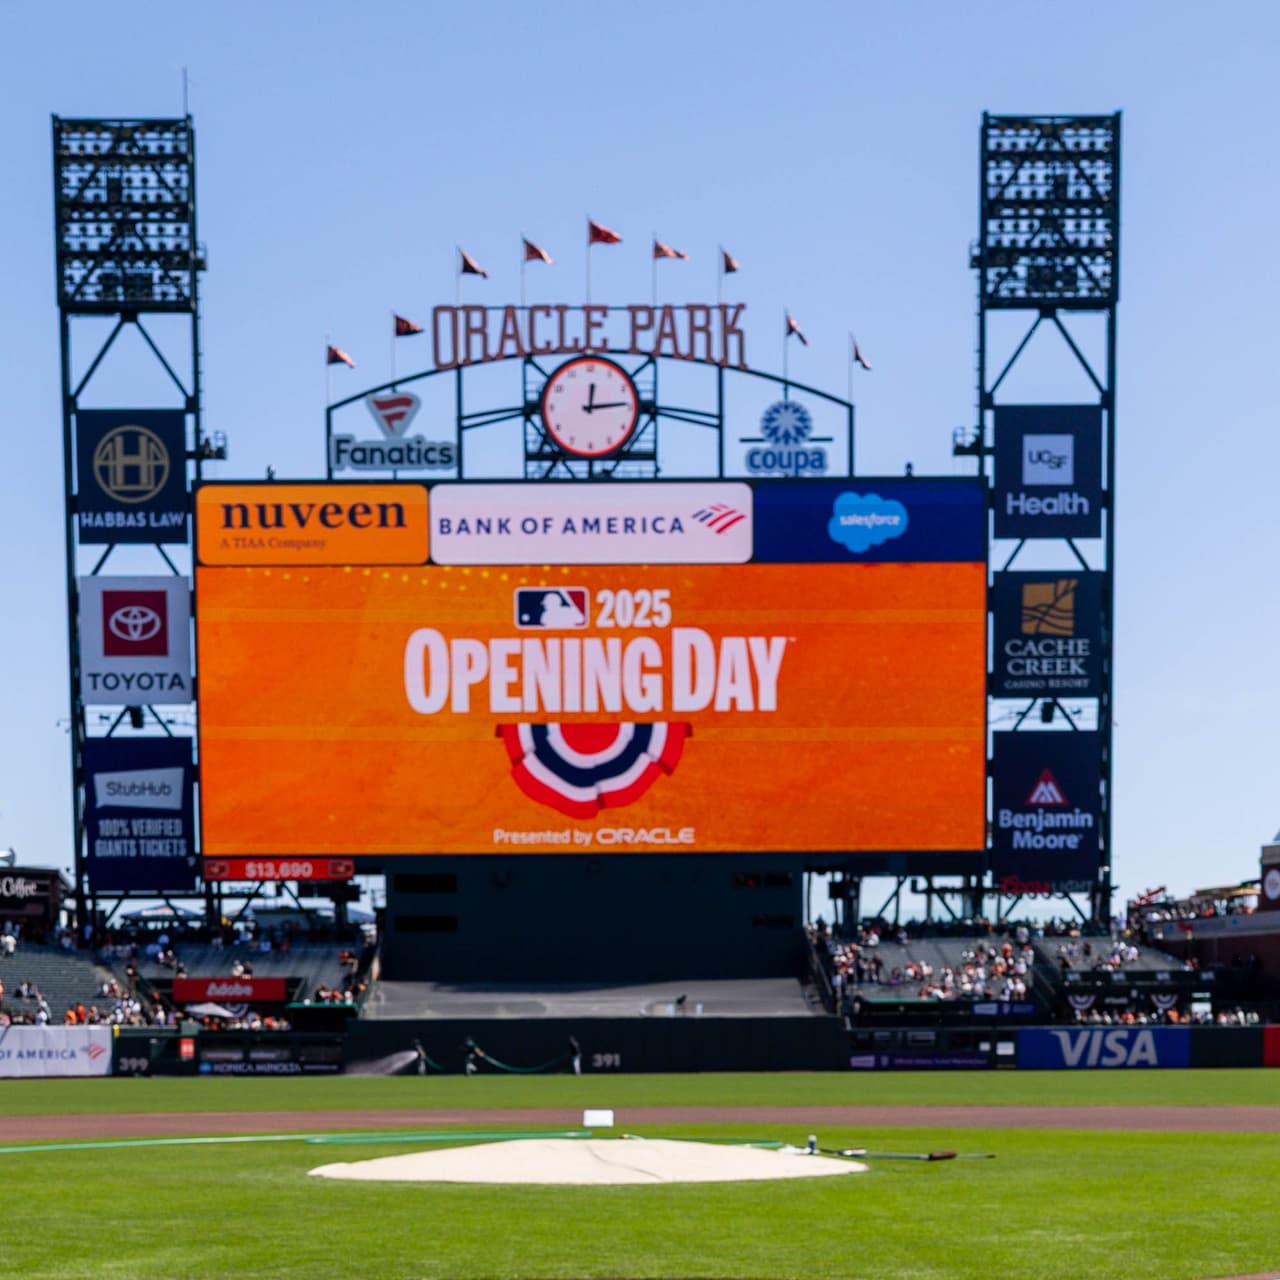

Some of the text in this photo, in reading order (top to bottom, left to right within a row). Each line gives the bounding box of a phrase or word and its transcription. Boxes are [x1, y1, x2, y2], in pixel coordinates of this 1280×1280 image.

[433, 303, 749, 370] ORACLE PARK
[334, 440, 453, 467] Fanatics
[748, 448, 826, 475] coupa
[1028, 448, 1068, 470] UCSF
[1007, 493, 1089, 516] Health
[80, 511, 184, 528] HABBAS LAW
[221, 501, 408, 529] nuveen
[839, 512, 900, 528] salesforce
[439, 516, 685, 536] BANK OF AMERICA
[220, 538, 326, 551] A TIAA Company
[595, 589, 672, 628] 2025
[1004, 638, 1090, 657] CACHE
[404, 627, 788, 715] OPENING DAY
[1007, 657, 1088, 676] CREEK
[88, 672, 186, 692] TOYOTA
[1003, 678, 1091, 690] CASINO RESORT
[105, 781, 173, 797] StubHub
[98, 818, 183, 837] 100% VERIFIED
[999, 809, 1093, 832] Benjamin
[493, 828, 695, 846] Presented by ORACLE
[1013, 831, 1078, 850] Moore
[94, 838, 187, 858] GIANTS TICKETS
[2, 877, 37, 899] Coffee
[16, 1049, 77, 1060] AMERICA
[1052, 1030, 1158, 1067] VISA
[120, 1058, 149, 1071] 399
[593, 1054, 620, 1068] 391
